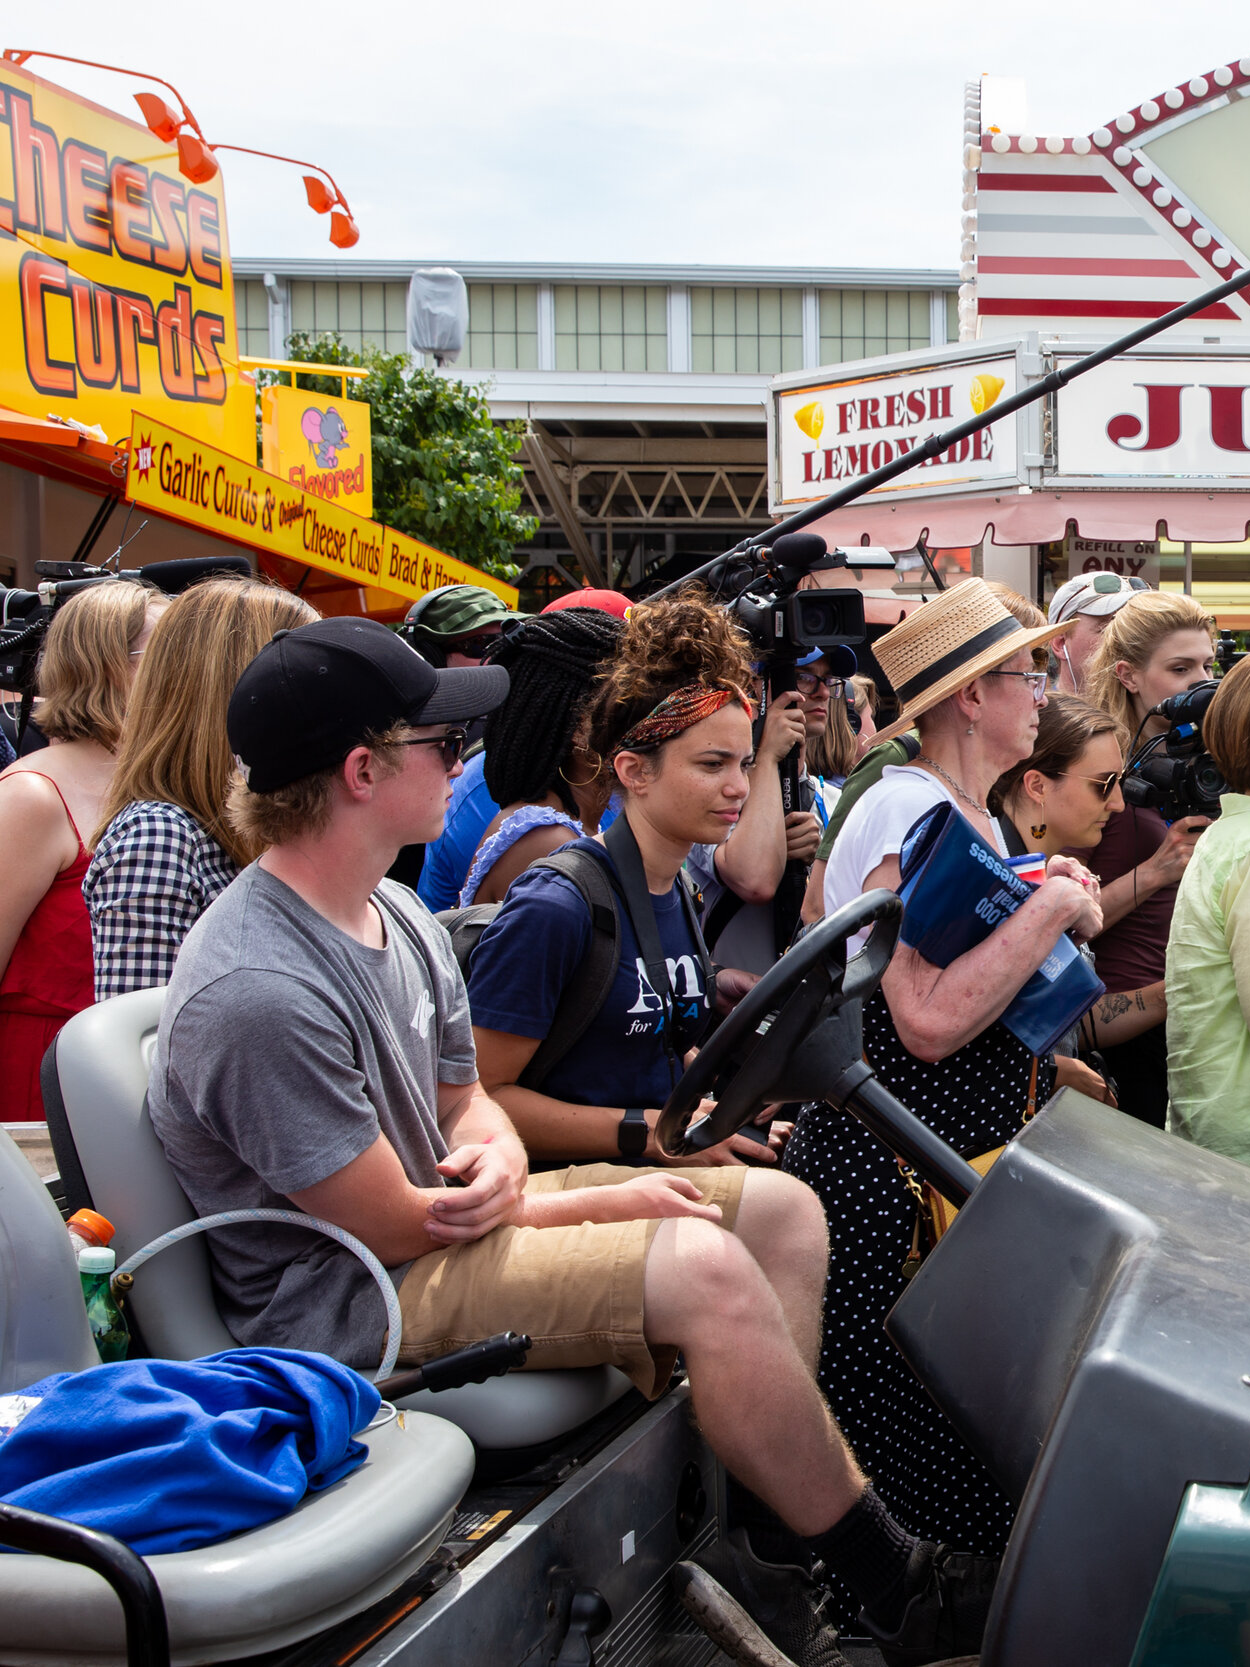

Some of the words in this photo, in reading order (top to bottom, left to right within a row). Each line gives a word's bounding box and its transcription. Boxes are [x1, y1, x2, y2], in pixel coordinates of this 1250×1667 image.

[0, 82, 223, 291] heese
[18, 250, 227, 407] Curds
[837, 384, 954, 435] FRESH
[289, 453, 364, 499] Flavored
[138, 447, 152, 470] NEW
[160, 442, 210, 508] Garlic
[214, 464, 258, 526] Curds
[262, 486, 275, 533] &
[302, 508, 346, 564] Cheese
[349, 528, 380, 576] Curds
[389, 543, 420, 586] Brad
[421, 556, 432, 591] &
[1075, 541, 1125, 553] REFILL
[1134, 543, 1155, 554] ON
[1082, 556, 1146, 577] ANY
[783, 777, 791, 809] BENRO
[991, 889, 1020, 914] mall
[626, 954, 711, 1013] Am
[625, 1019, 652, 1036] for
